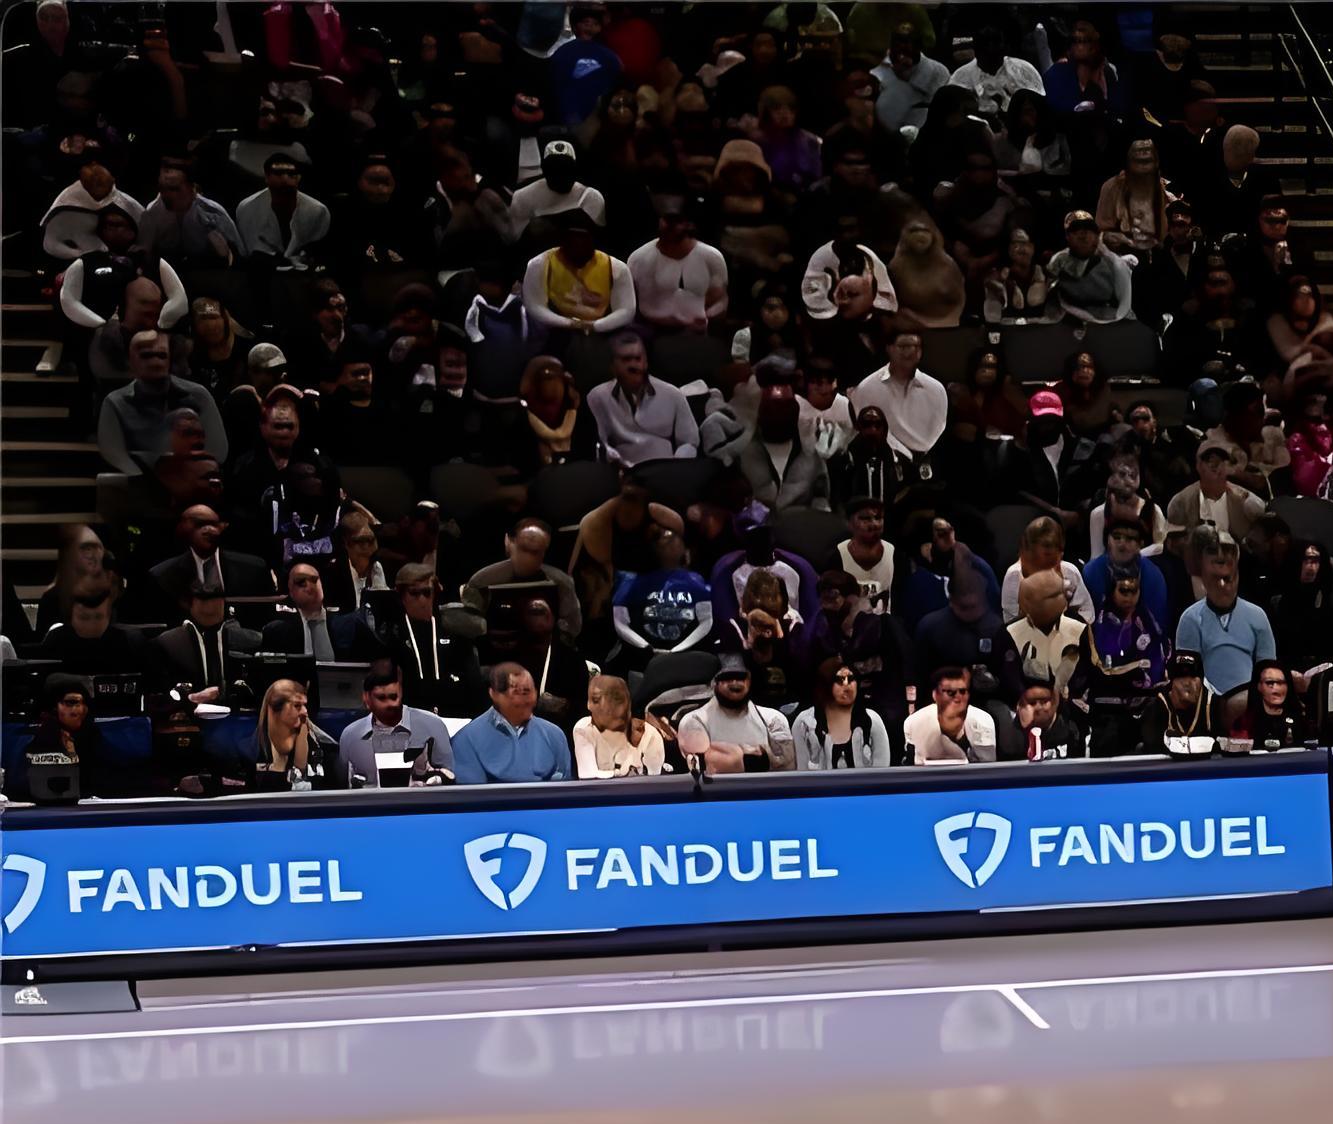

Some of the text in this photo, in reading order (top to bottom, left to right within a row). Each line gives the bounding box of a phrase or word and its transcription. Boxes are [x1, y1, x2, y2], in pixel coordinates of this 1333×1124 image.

[566, 839, 838, 890] FANDUEL
[1030, 816, 1285, 867] FANDUEL
[68, 860, 362, 912] FANDUEL
